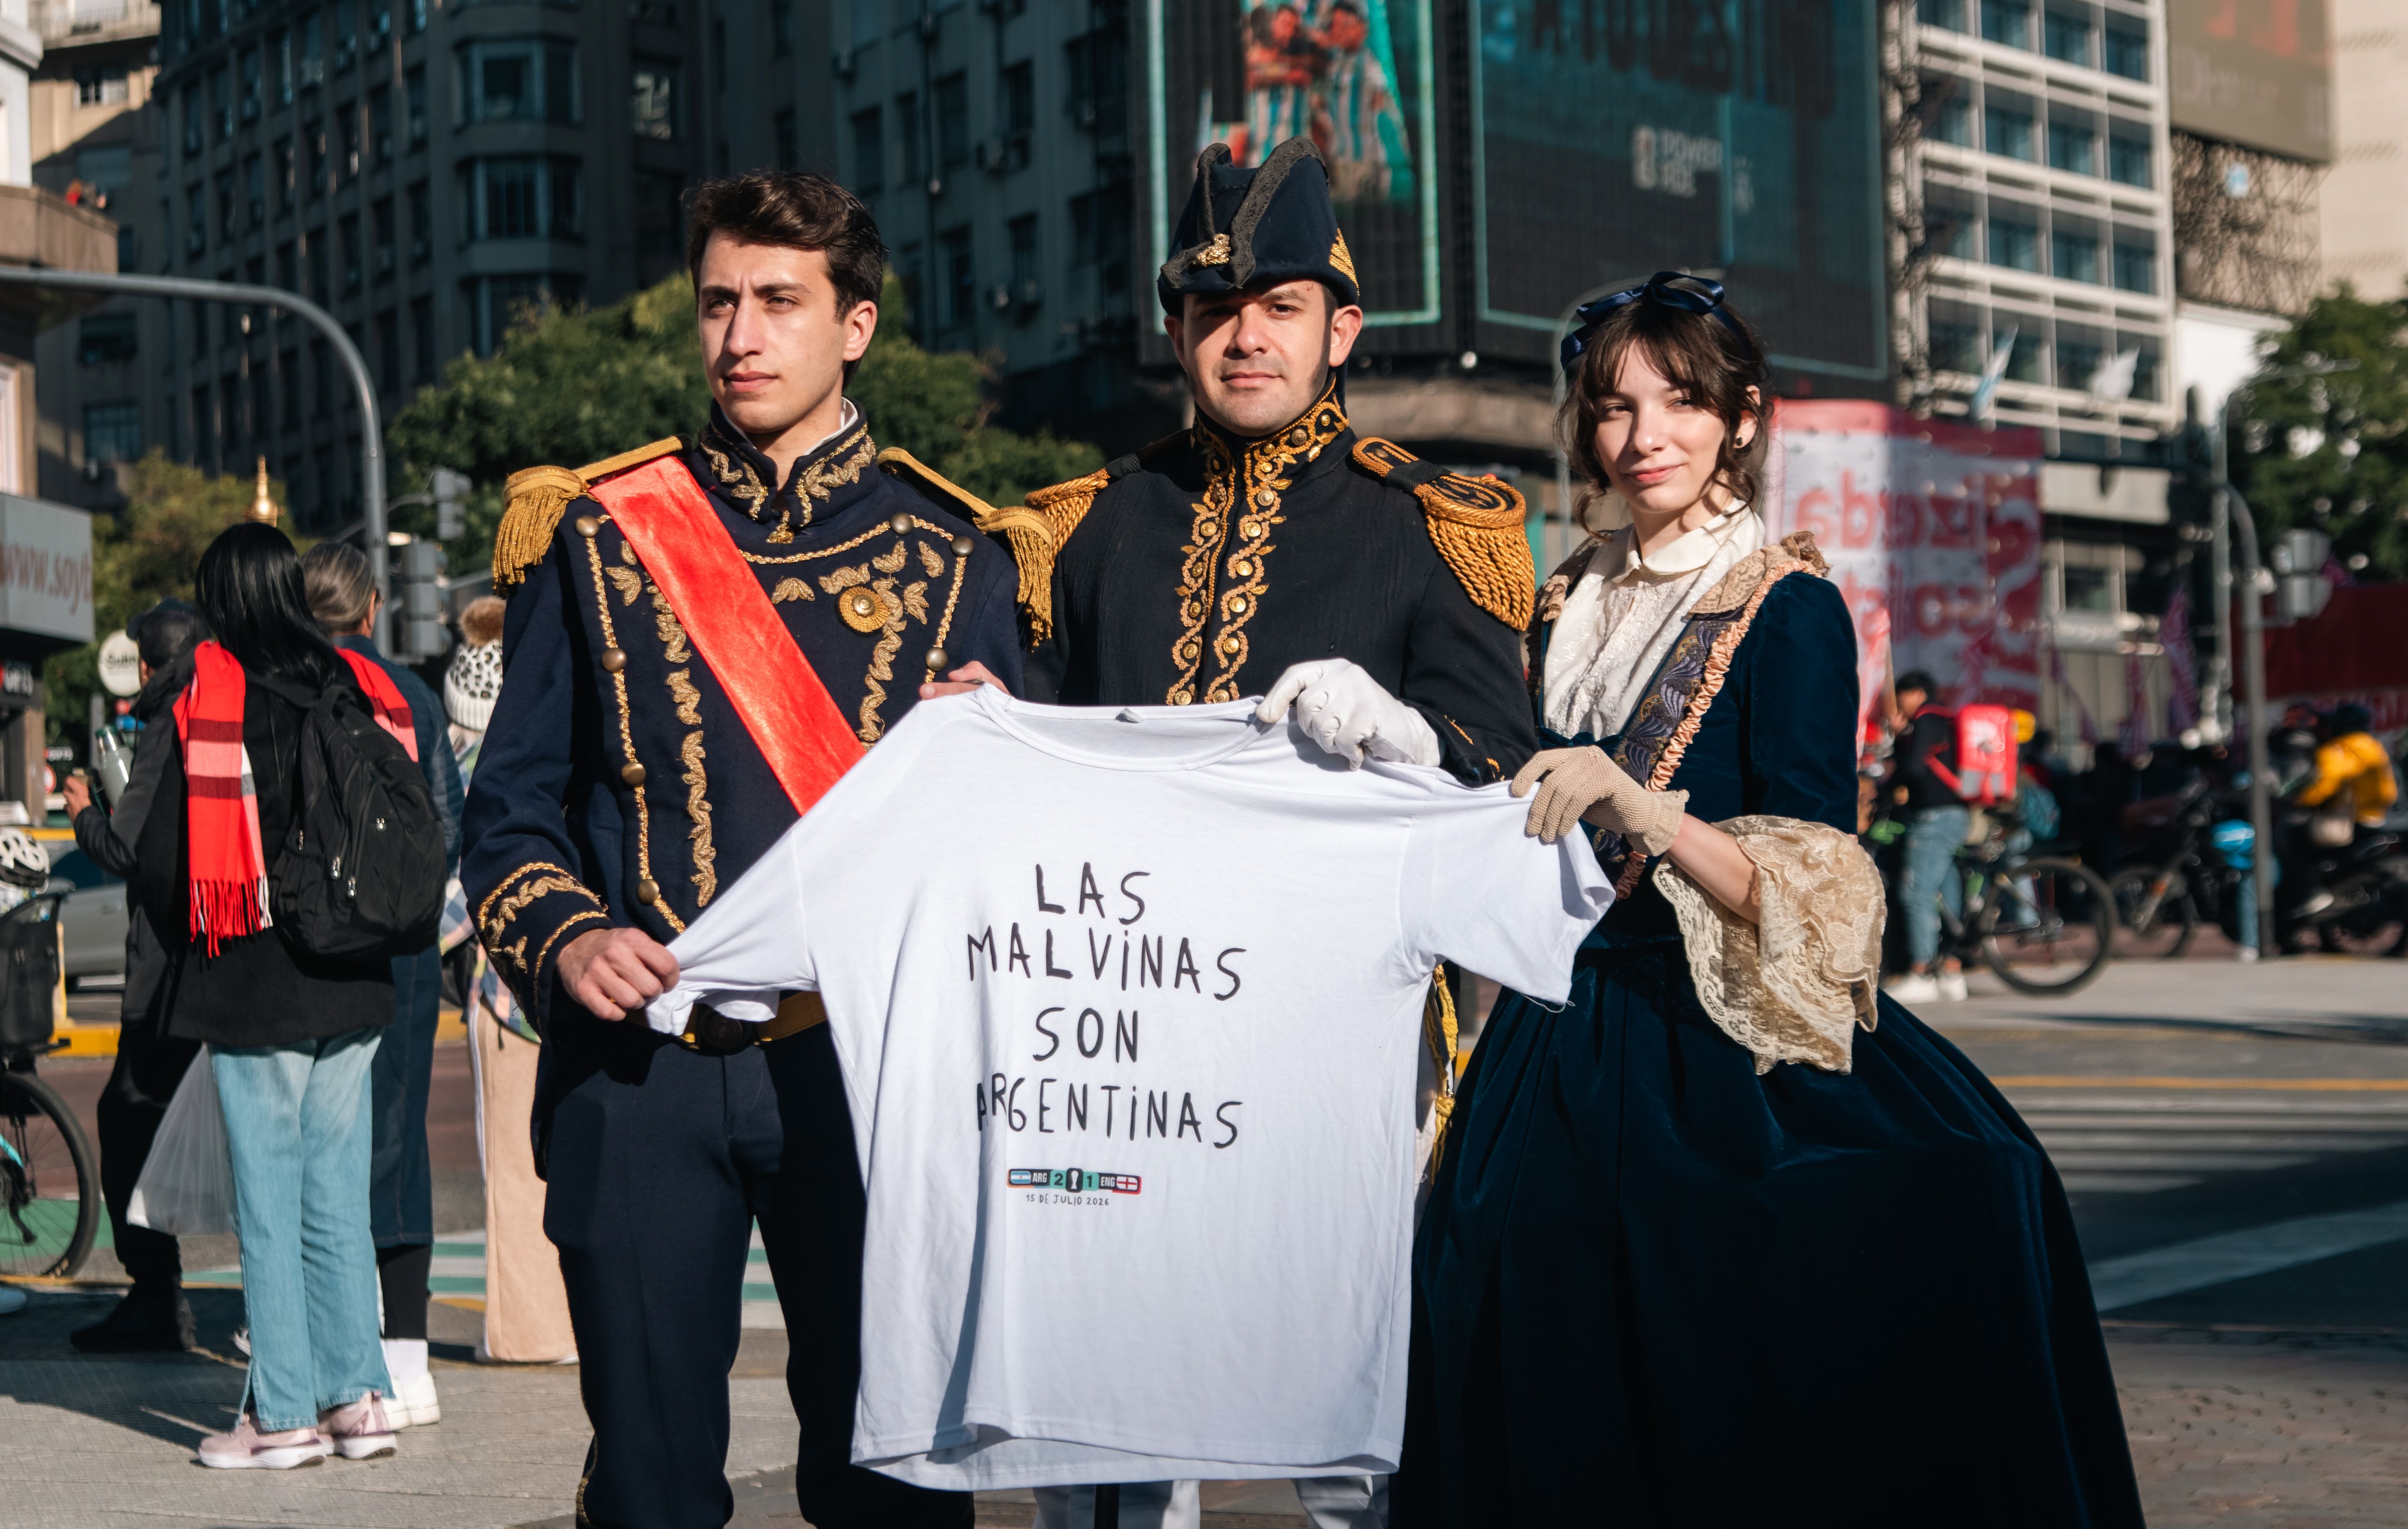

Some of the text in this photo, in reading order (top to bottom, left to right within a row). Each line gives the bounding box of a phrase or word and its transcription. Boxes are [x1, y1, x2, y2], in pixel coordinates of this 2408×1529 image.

[1035, 862, 1151, 925] LAS
[1032, 1007, 1139, 1063] SON
[1032, 1172, 1115, 1188] ARG 2 1 ENG
[1026, 1194, 1035, 1202] 15
[1039, 1194, 1049, 1204] DE
[1087, 1197, 1110, 1206] 2026
